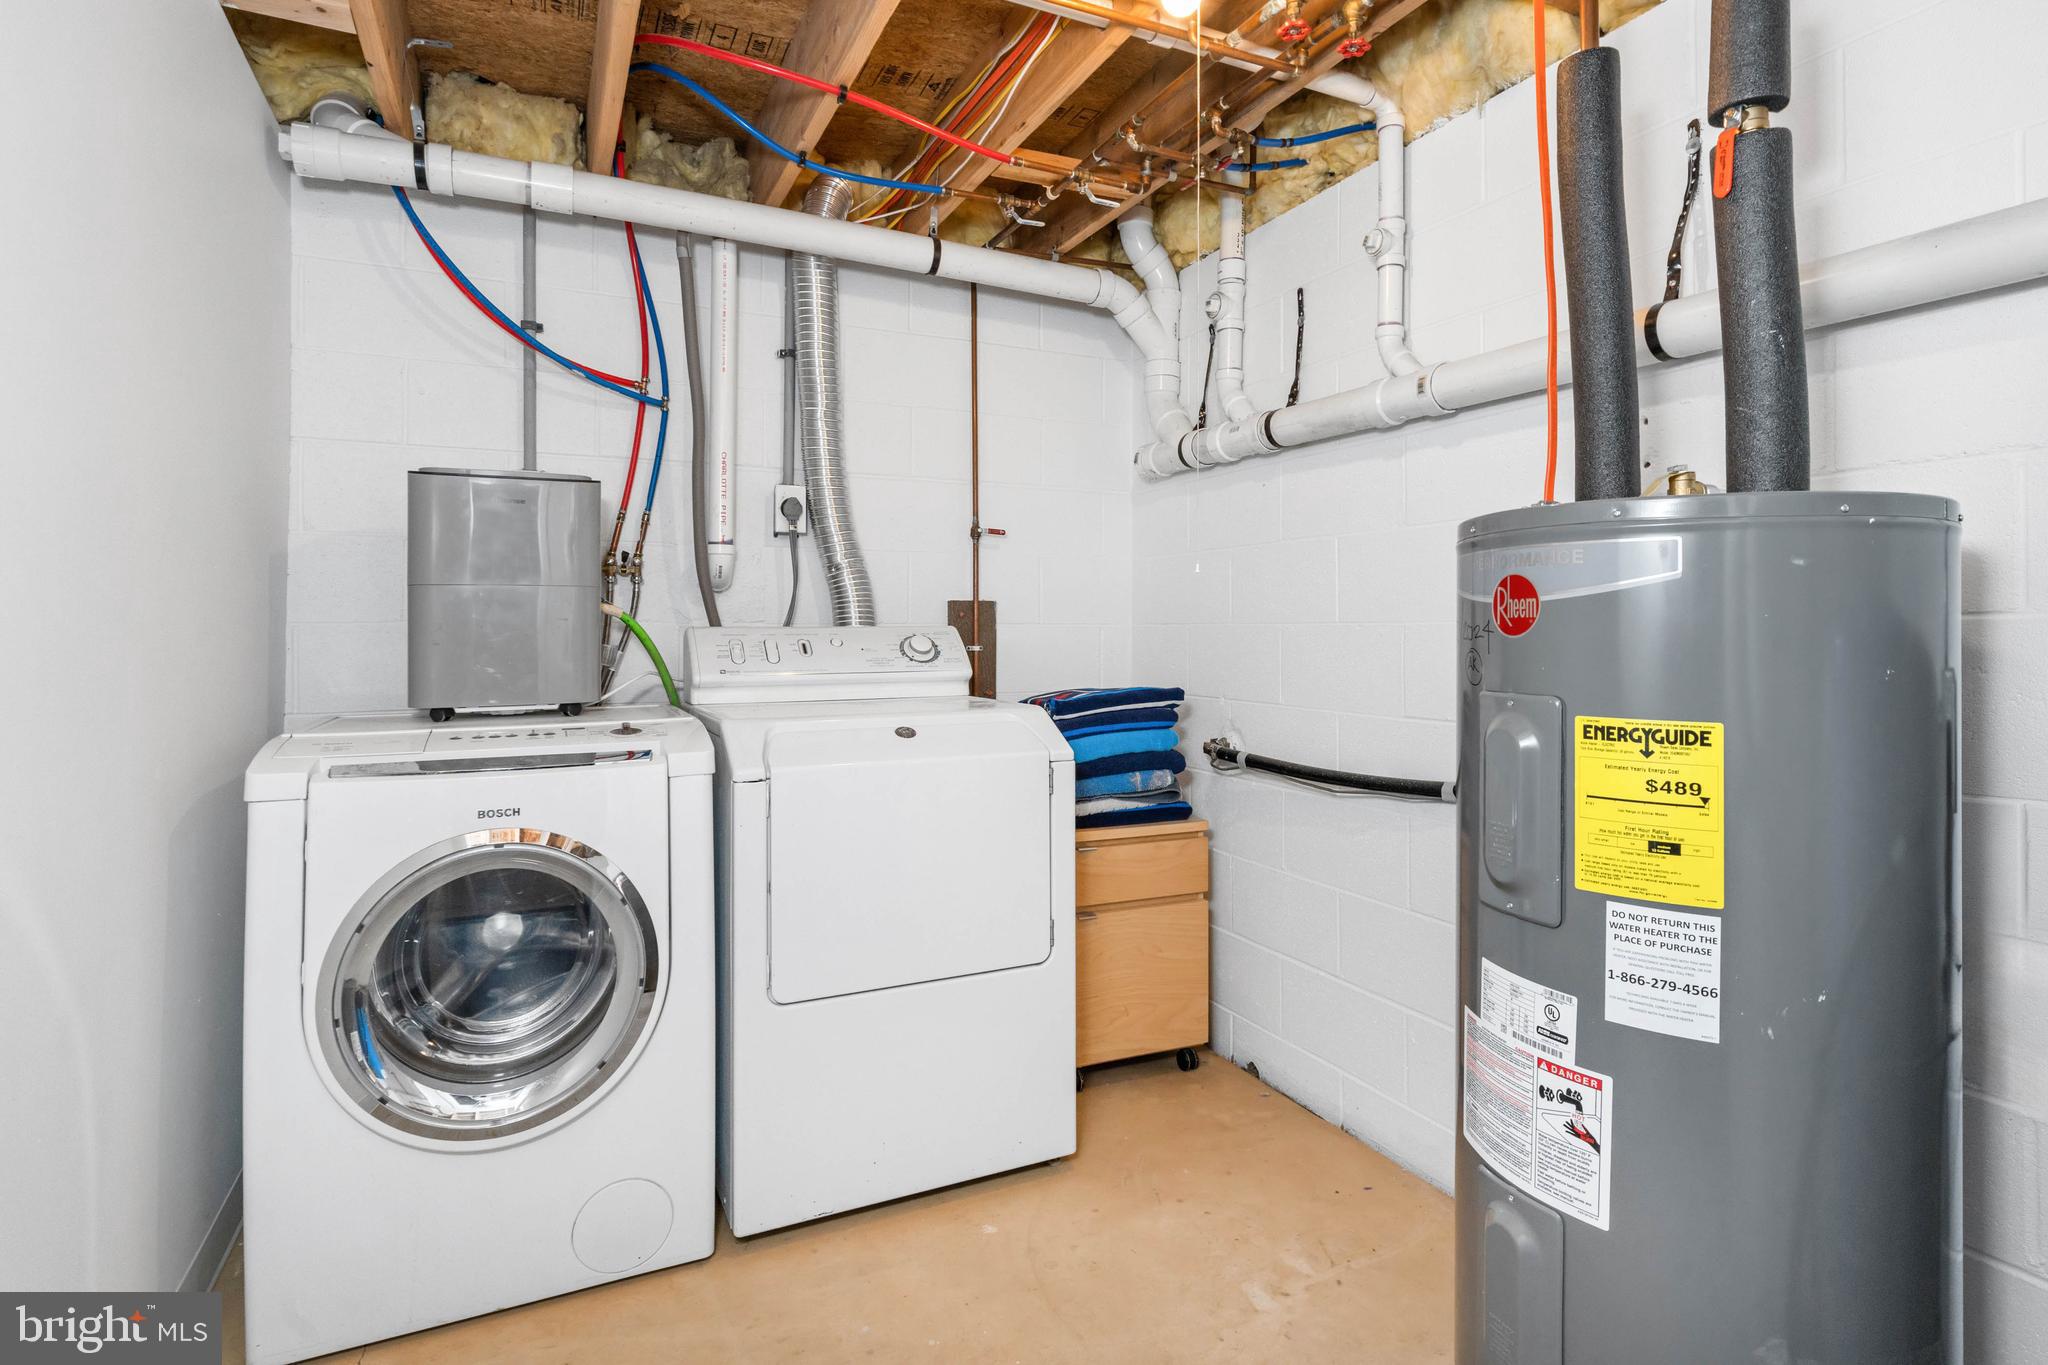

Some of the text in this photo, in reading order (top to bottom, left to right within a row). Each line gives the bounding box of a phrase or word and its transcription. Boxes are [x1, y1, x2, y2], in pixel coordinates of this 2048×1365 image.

[1496, 576, 1537, 627] Rheem
[1583, 724, 1712, 747] ENERGYGUIDE
[1646, 779, 1702, 796] $489
[478, 808, 520, 819] BOSCH
[1652, 828, 1669, 836] Rating
[1612, 910, 1715, 932] DO NOT RETURN THIS
[1609, 921, 1718, 945] WATER HEATER TO THE
[1614, 933, 1712, 956] PLACE OF PURCHASE
[1608, 969, 1718, 999] 1-866-279-4566
[1551, 1066, 1598, 1089] DANGER
[1571, 1112, 1585, 1122] HOT
